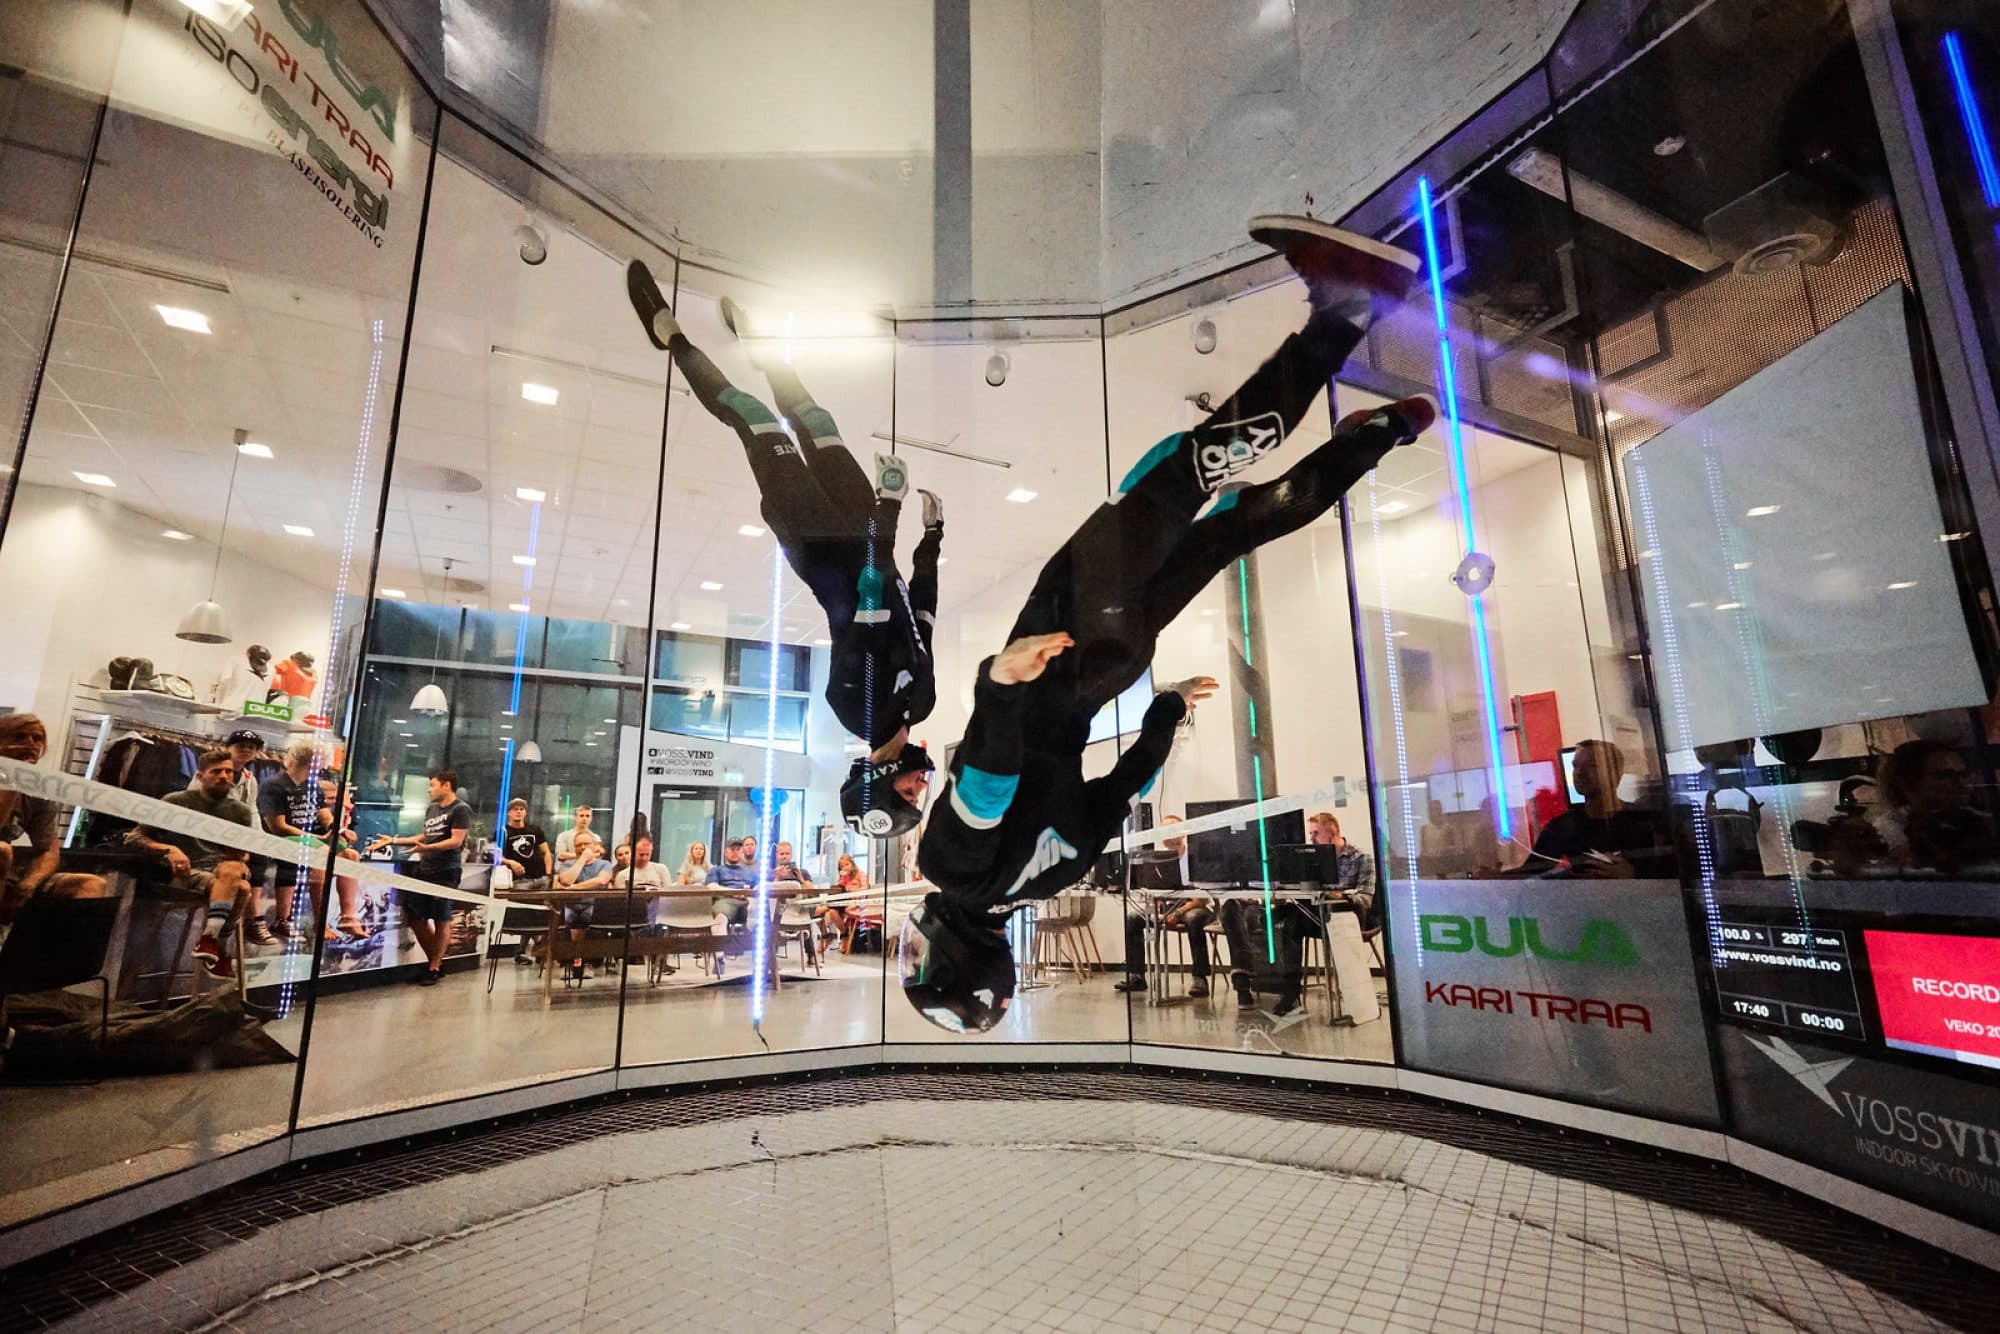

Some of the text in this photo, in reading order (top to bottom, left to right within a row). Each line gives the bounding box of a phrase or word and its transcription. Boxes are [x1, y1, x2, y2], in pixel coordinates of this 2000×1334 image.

[243, 8, 393, 190] ARI TRAA
[248, 703, 290, 717] BULA
[1419, 914, 1640, 967] BULA
[1781, 932, 1807, 946] 297
[1717, 948, 1841, 972] www.vossvind.no
[1912, 977, 2000, 1003] RECORD
[1425, 981, 1652, 1034] KARI TRAA
[1733, 1001, 1845, 1032] 17:40 00:00
[1944, 1018, 1985, 1036] VEKO
[1855, 1136, 1917, 1169] INDOOR
